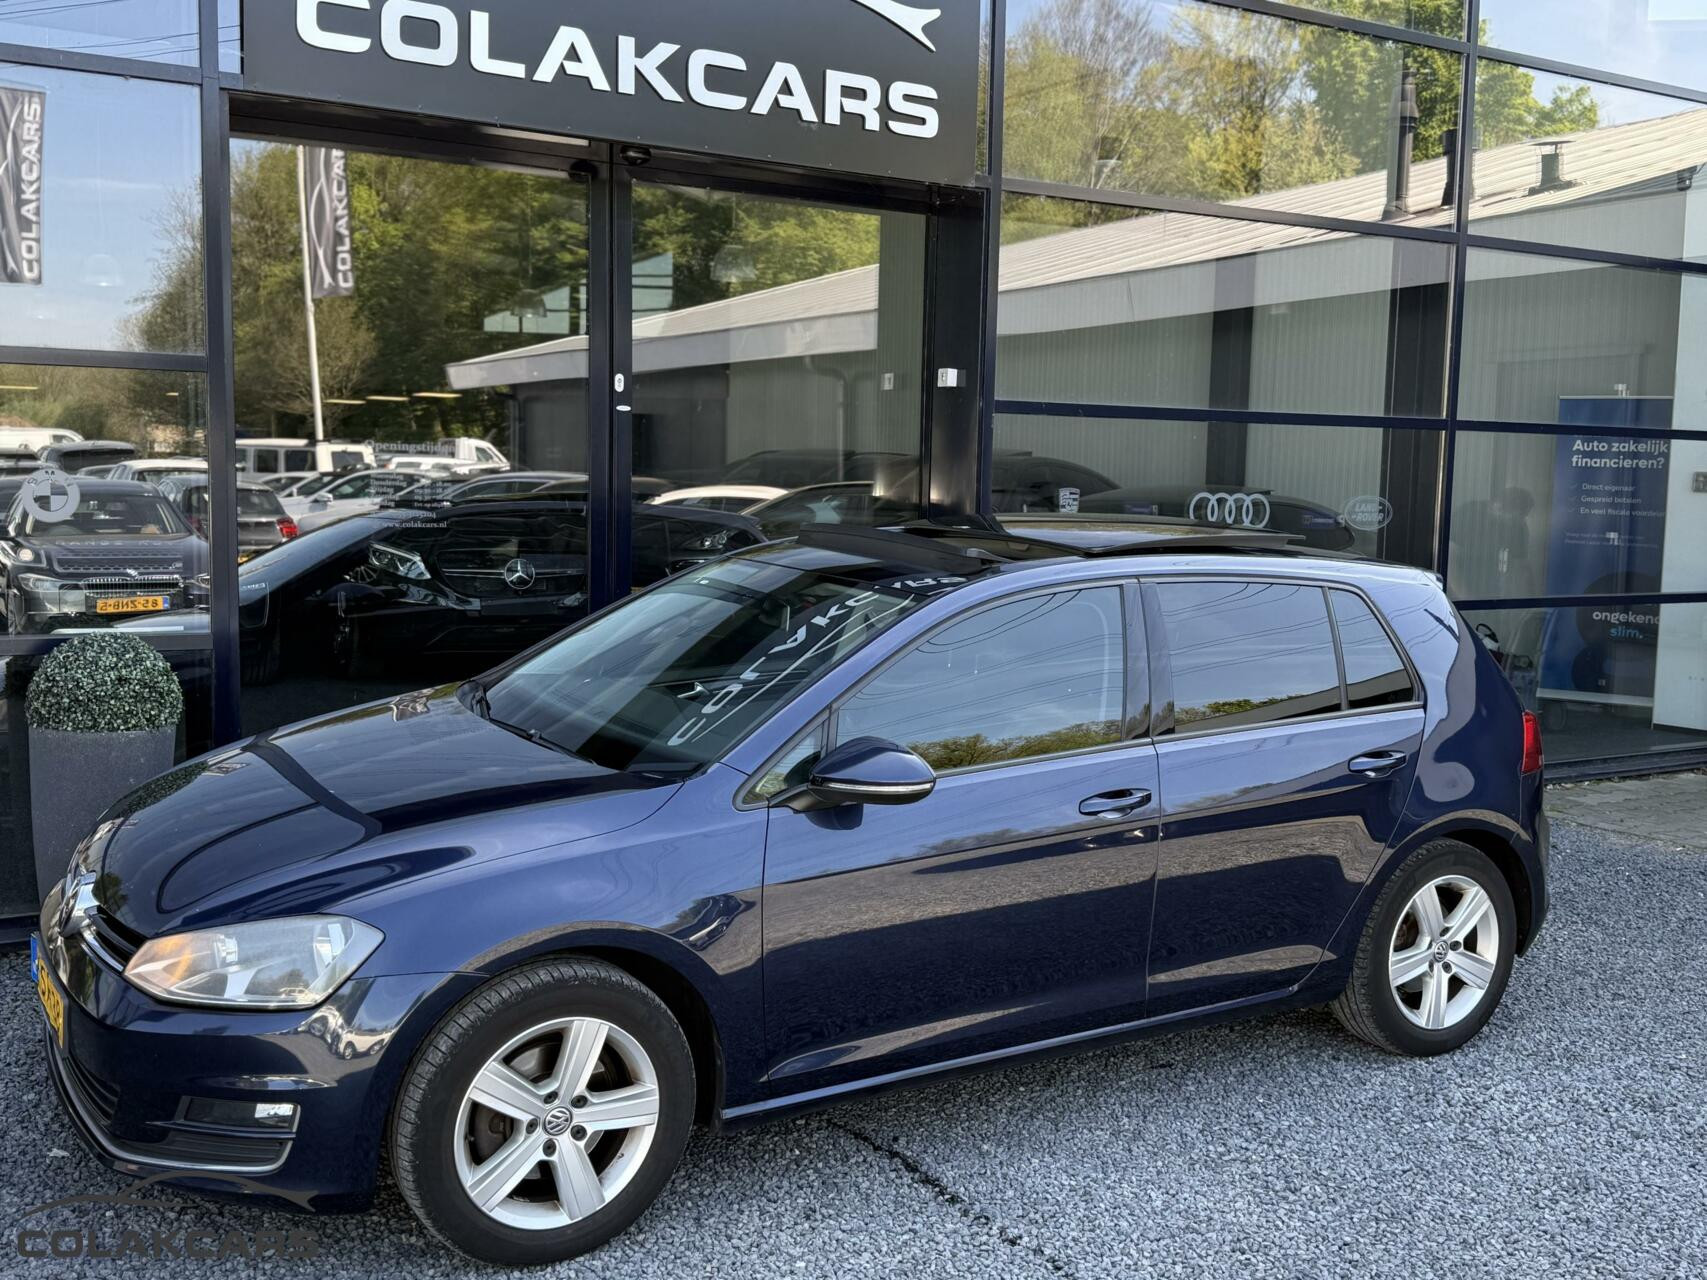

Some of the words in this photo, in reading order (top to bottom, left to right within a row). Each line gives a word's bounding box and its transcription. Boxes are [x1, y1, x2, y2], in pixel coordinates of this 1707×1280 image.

[295, 0, 940, 138] COLAKCARS
[20, 96, 42, 280] COLAKCARS
[1572, 439, 1608, 452] Auto
[1611, 439, 1669, 455] zakelijk
[1571, 455, 1665, 469] financieren?
[1609, 625, 1644, 639] slim.
